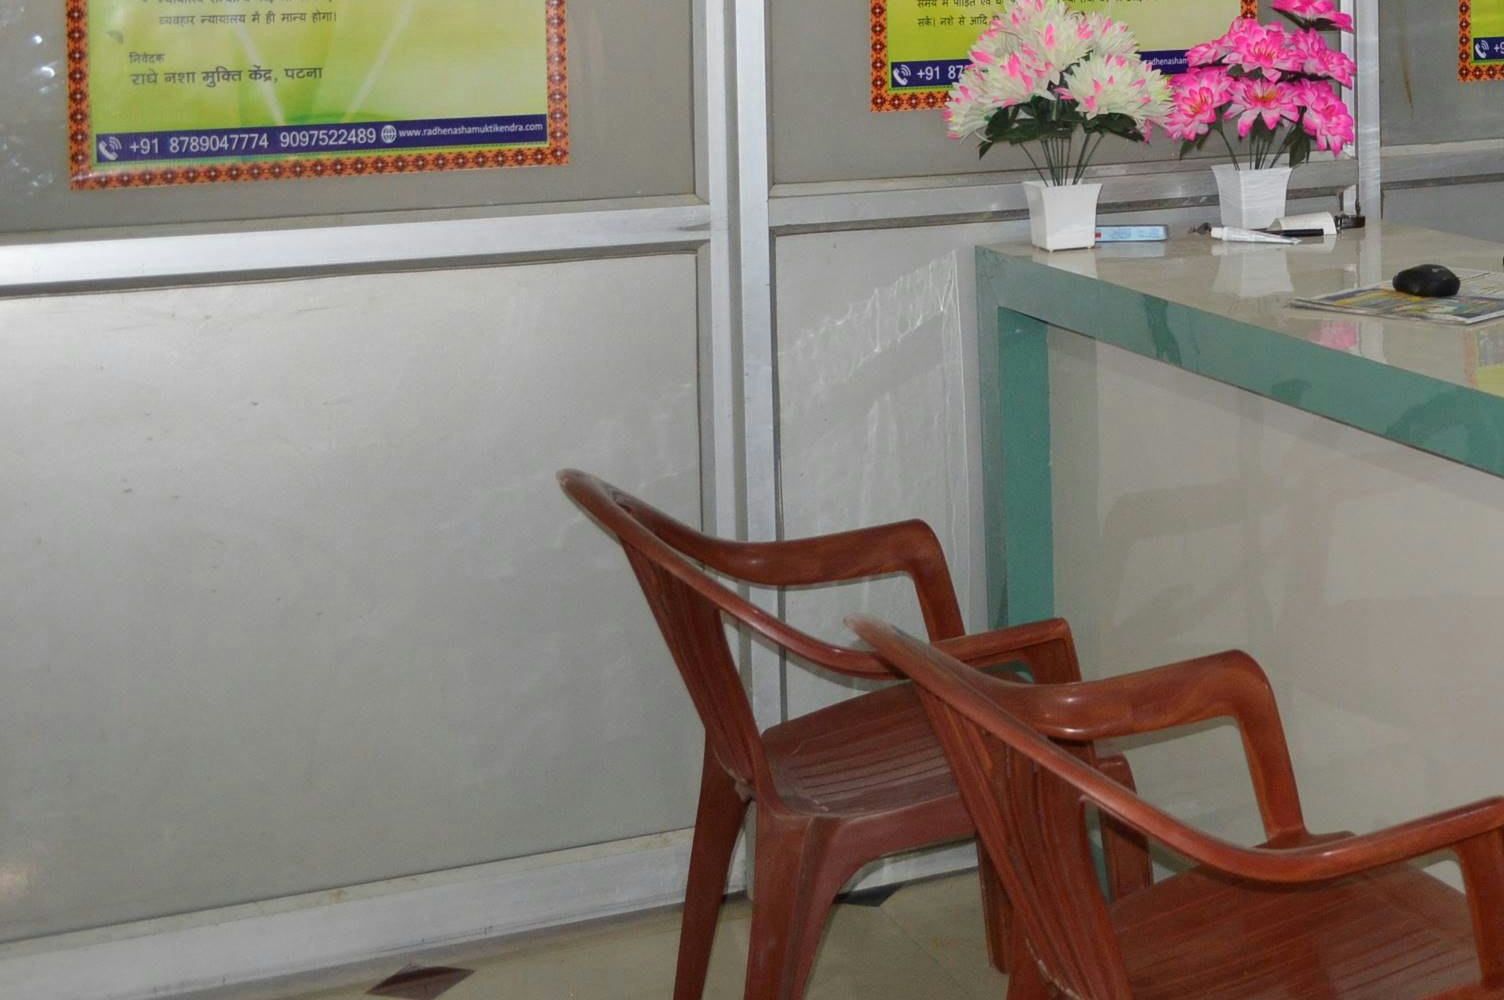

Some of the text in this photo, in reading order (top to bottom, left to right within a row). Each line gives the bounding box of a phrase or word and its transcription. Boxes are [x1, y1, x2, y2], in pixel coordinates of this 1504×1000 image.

[132, 64, 323, 88] राधे नशा मुक्ति केंद्र, पटना
[916, 66, 939, 80] +91
[129, 122, 543, 155] +91 8789047774 9097522489 www.radhenashamuktikendra.com
